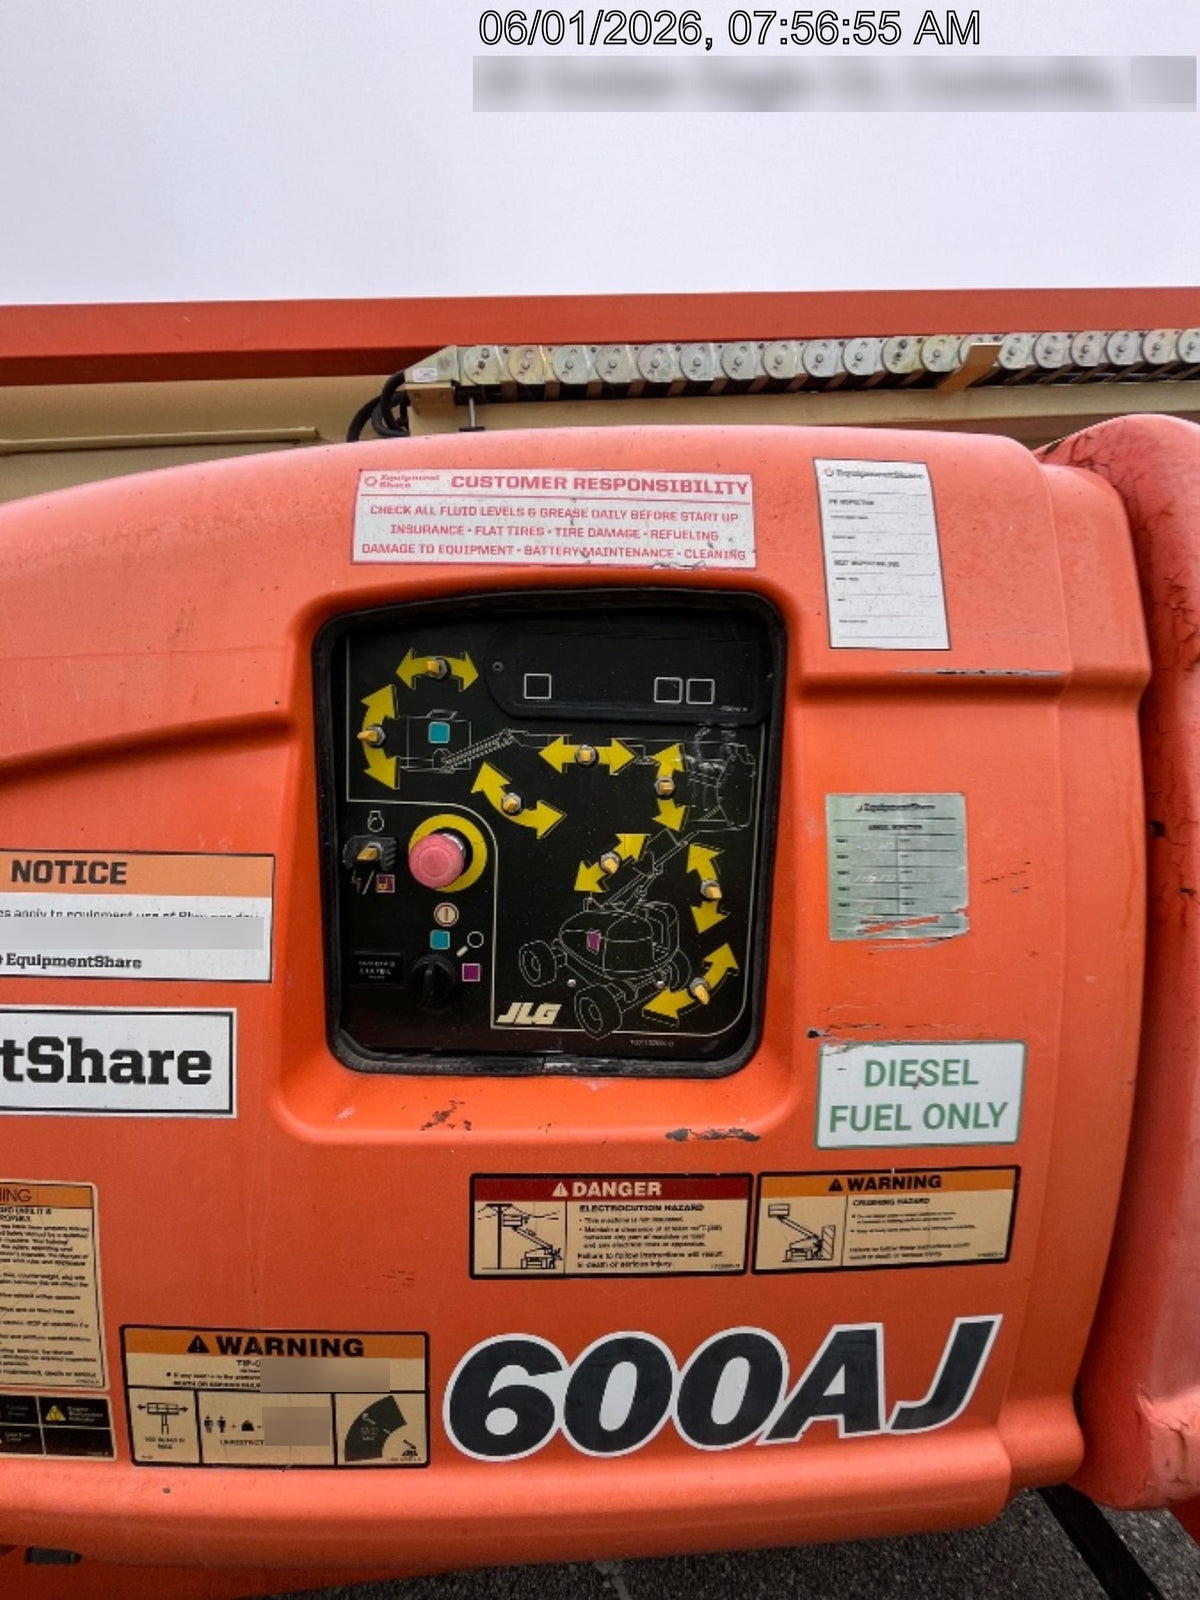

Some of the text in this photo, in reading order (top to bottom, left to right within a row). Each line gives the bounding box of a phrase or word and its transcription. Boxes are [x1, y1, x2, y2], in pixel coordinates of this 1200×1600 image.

[451, 476, 748, 495] CUSTOMER RESPONSIBILITY
[370, 504, 412, 516] CHECK
[415, 506, 436, 516] ALL
[440, 506, 477, 517] FLUID
[481, 506, 525, 518] LEVELS
[540, 508, 587, 519] GREASE
[591, 510, 627, 520] DAILY
[631, 511, 678, 521] BEFORE
[681, 512, 718, 522] START
[722, 513, 739, 523] UP
[390, 524, 719, 541] INSURANCE FLAT TIRES TIRE DAMAGE REFUELING
[362, 543, 746, 560] DAMAGE TO EQUIPMENT BATTERY MAINTENANCE CLEANING
[11, 859, 128, 885] NOTICE
[7, 953, 142, 970] EquipmentShare
[496, 1002, 562, 1025] JLG
[864, 1059, 980, 1088] DIESEL
[830, 1102, 1009, 1133] FUEL ONLY
[572, 1181, 663, 1198] DANGER
[848, 1174, 943, 1192] WARNING
[579, 1203, 705, 1213] ELECTROCUTION HAZARD
[216, 1335, 365, 1358] WARNING
[235, 1360, 261, 1368] TIP-O
[442, 1314, 1003, 1464] 600AJ
